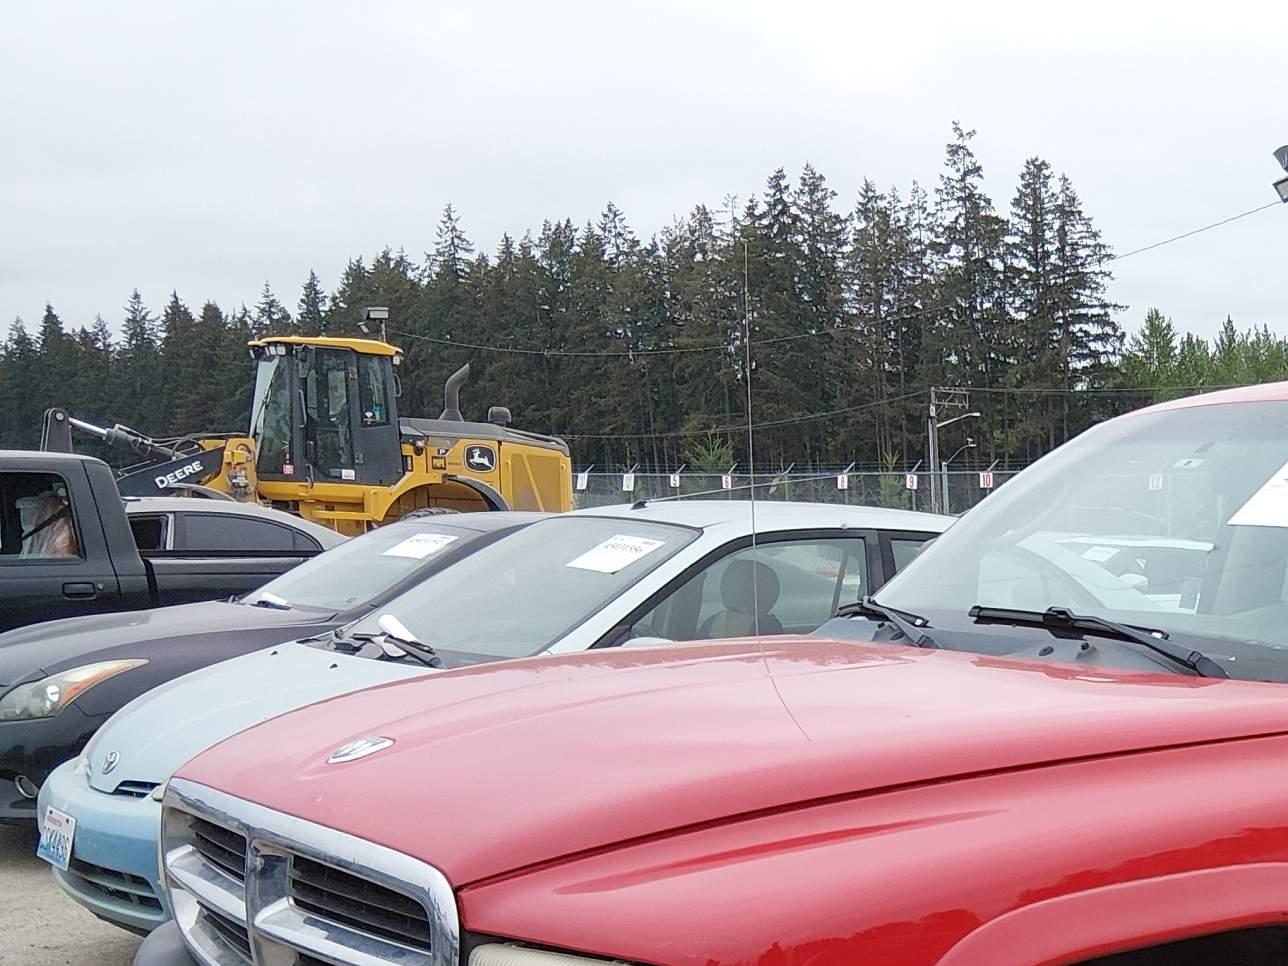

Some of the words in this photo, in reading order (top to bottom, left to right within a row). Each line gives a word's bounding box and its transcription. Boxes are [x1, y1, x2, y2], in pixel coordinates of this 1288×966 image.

[154, 460, 204, 489] DEERE
[839, 475, 845, 488] 8
[908, 475, 914, 488] 9
[982, 473, 992, 488] 10
